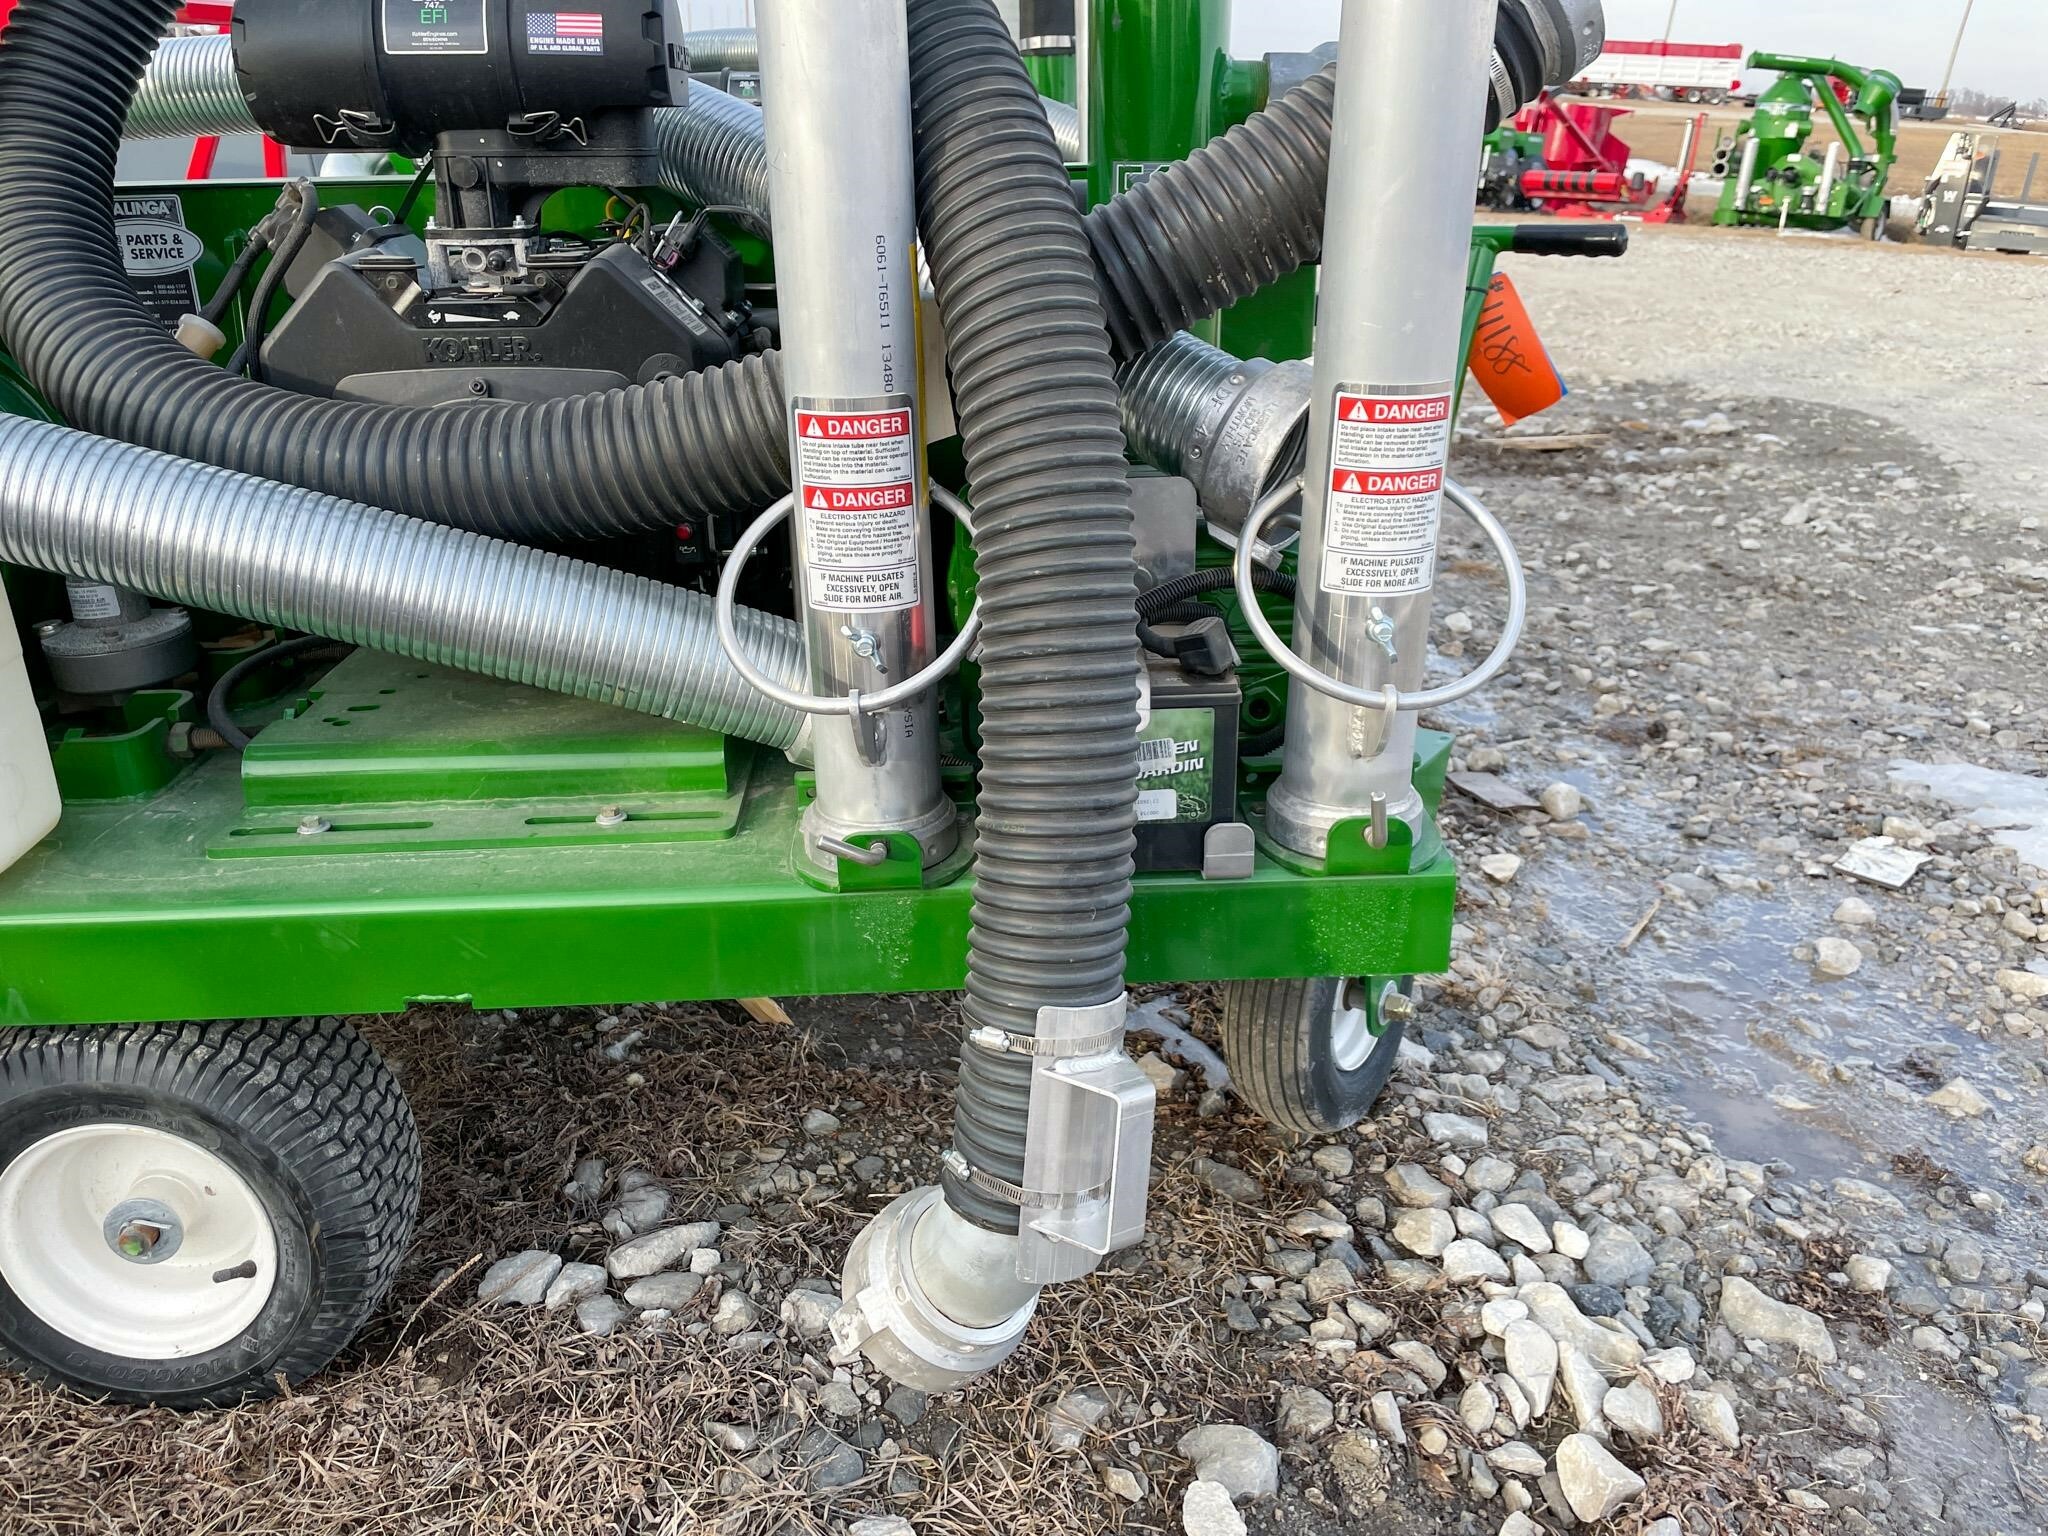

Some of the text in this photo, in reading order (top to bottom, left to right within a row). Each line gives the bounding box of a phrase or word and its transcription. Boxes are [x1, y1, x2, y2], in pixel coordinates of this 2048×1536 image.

[420, 9, 447, 24] EFI
[114, 201, 170, 215] ALINGA
[126, 234, 183, 245] PARTS &
[131, 247, 184, 259] SERVICE
[876, 235, 894, 393] 6061-T6511 13480
[422, 336, 532, 363] KOHLER
[1374, 402, 1445, 420] DANGER
[827, 417, 902, 436] DANGER
[1220, 396, 1256, 452] MONTHLY
[1368, 473, 1437, 492] DANGER
[832, 489, 906, 507] DANGER
[1412, 494, 1434, 502] HAZARD
[880, 510, 905, 518] HAZARD
[1350, 558, 1388, 567] MACHINE
[1390, 556, 1424, 566] PULSATES
[829, 574, 864, 582] MACHINE
[866, 571, 904, 582] PULSATES
[1346, 568, 1398, 578] EXCESSIVELY,
[1401, 568, 1419, 576] OPEN
[826, 583, 899, 593] EXCESSIVELY, OPEN
[1341, 578, 1363, 587] SLIDE
[1384, 578, 1406, 587] MORE
[824, 594, 843, 602] SLIDE
[864, 594, 886, 603] MORE
[889, 592, 903, 600] AIR.
